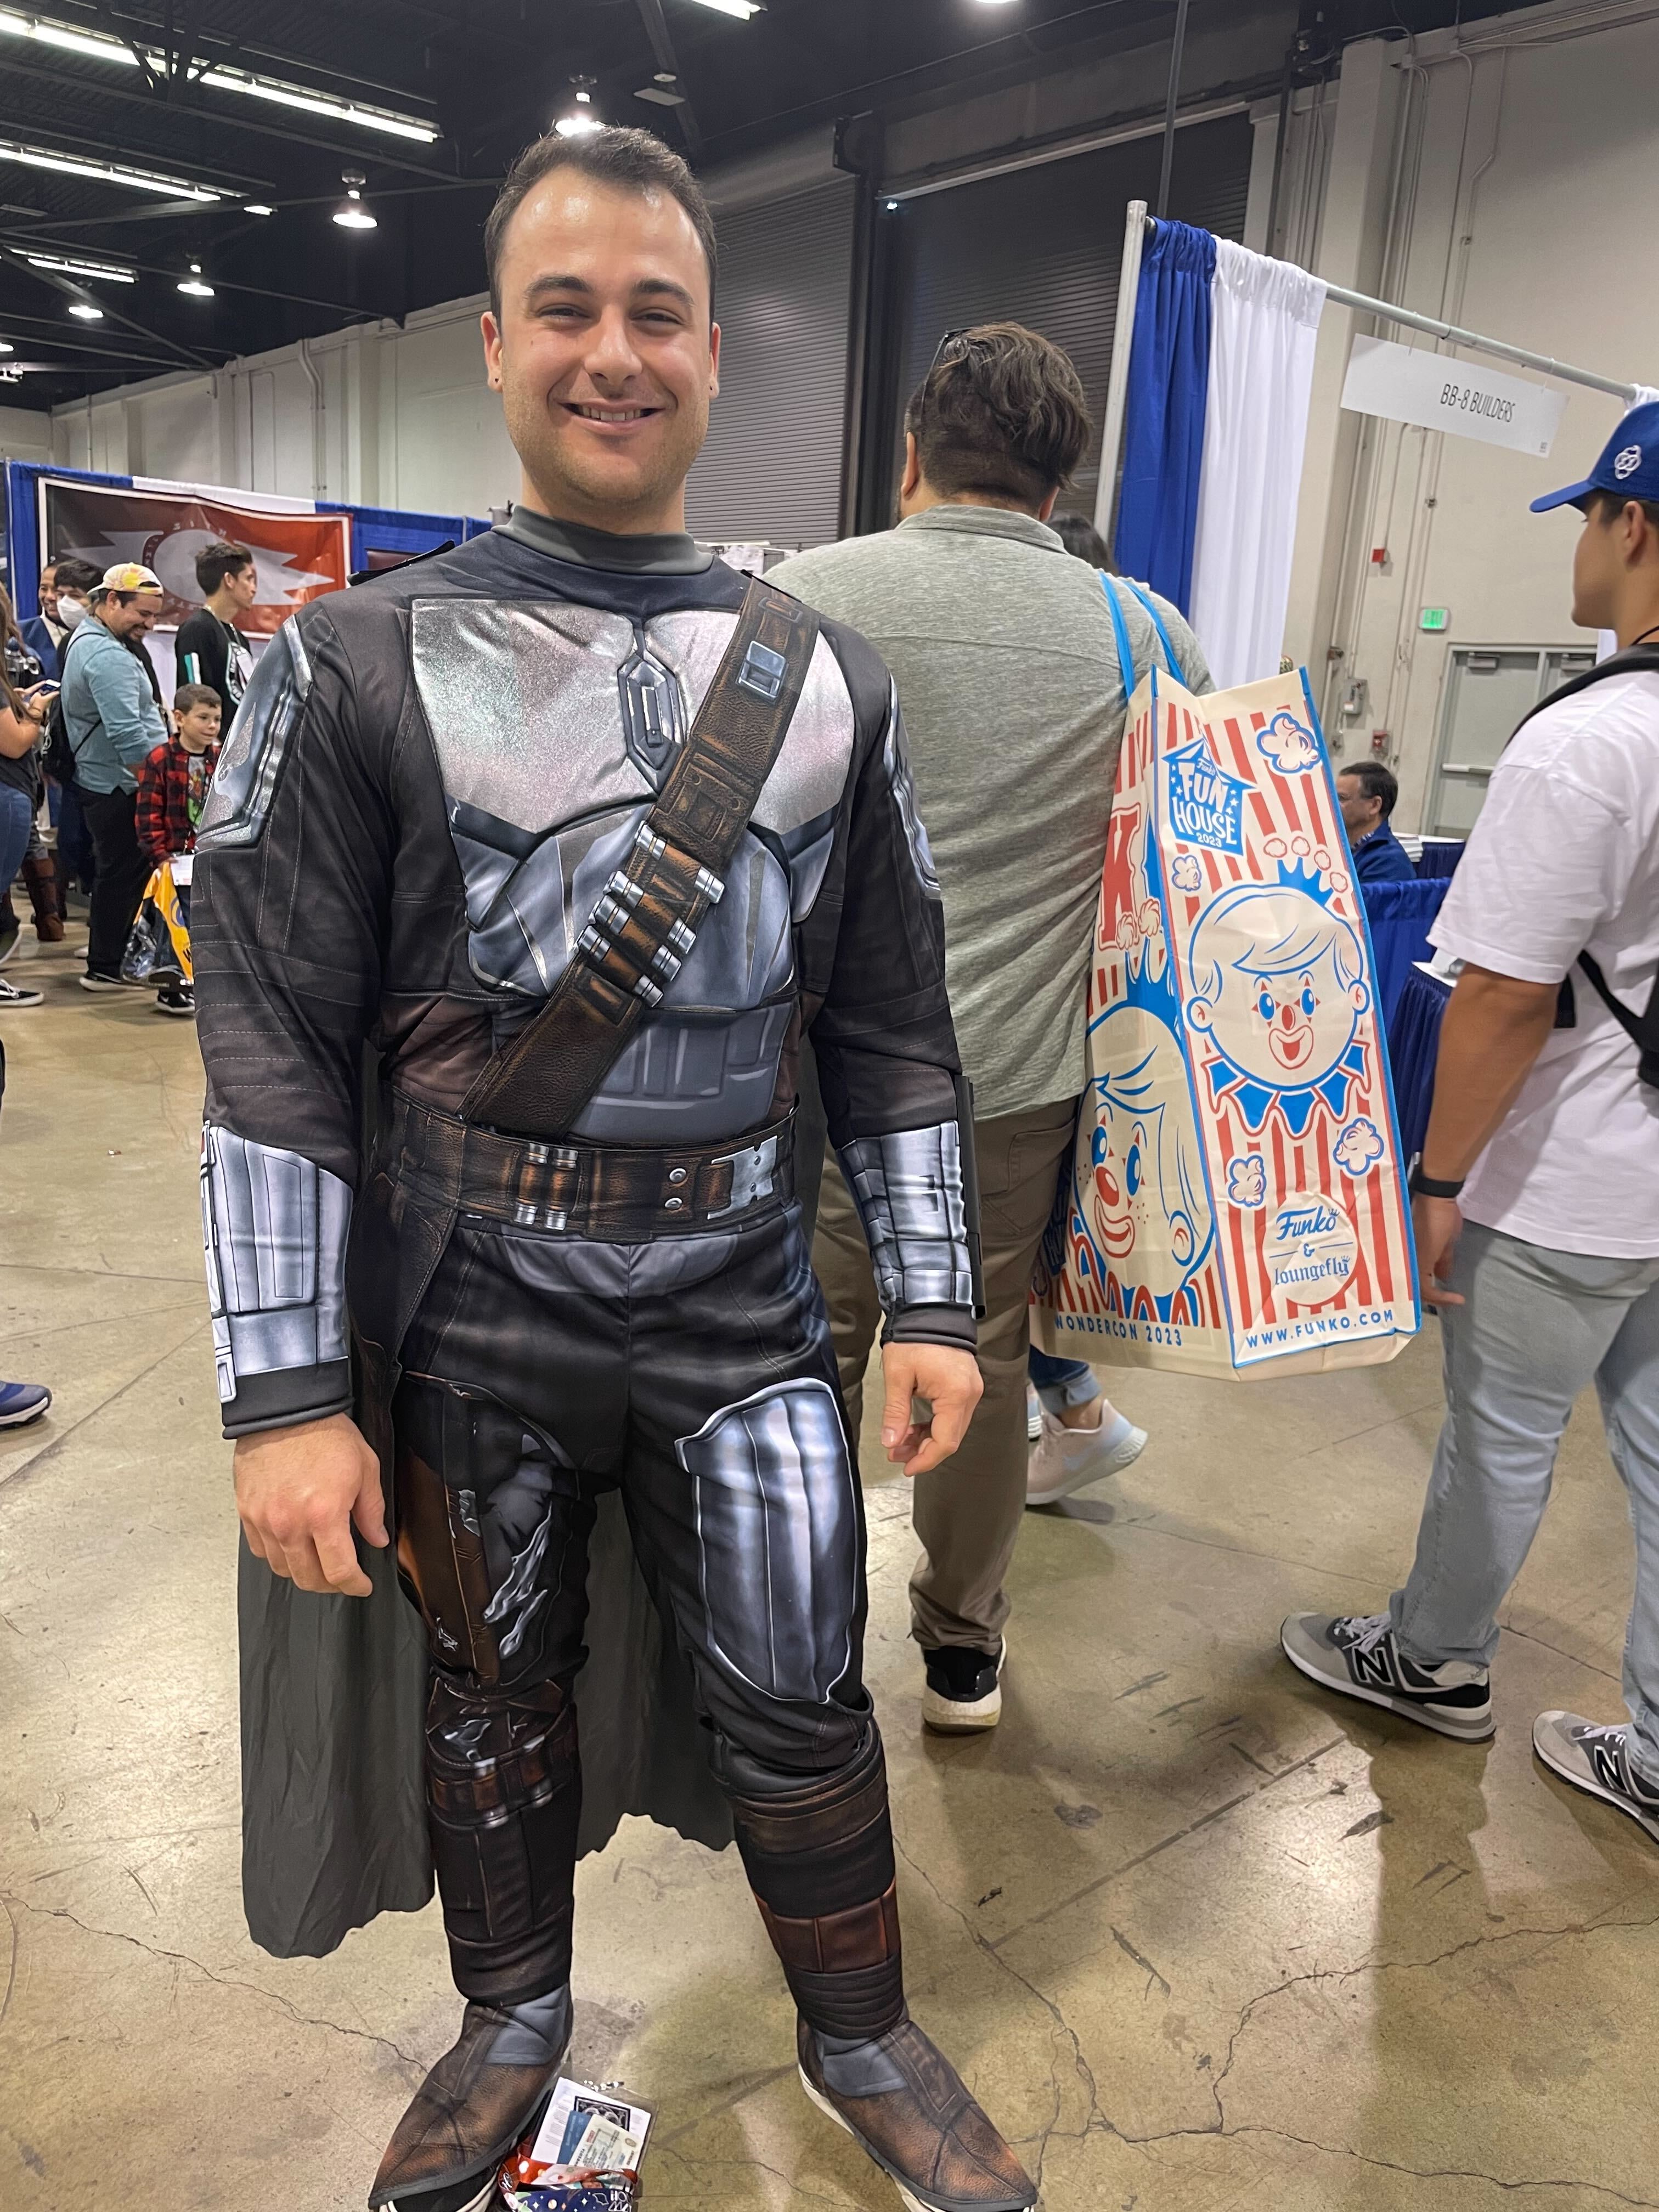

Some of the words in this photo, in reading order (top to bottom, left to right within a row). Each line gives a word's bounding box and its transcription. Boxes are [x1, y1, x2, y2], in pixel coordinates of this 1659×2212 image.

[1440, 383, 1471, 410] BB-8
[1469, 391, 1516, 422] BUILDERS
[1178, 762, 1229, 814] FUN
[1171, 796, 1238, 845] HOUSE
[1196, 832, 1222, 848] 2023
[1276, 1205, 1336, 1240] Funko
[1303, 1243, 1315, 1257] &
[1274, 1257, 1350, 1285] loungefly
[1054, 1316, 1138, 1340] WONDERCON
[1146, 1325, 1182, 1346] 2023
[1246, 1309, 1393, 1348] WWW.FUNKO.COM
[1352, 1646, 1395, 1686] N
[1594, 1746, 1632, 1795] N
